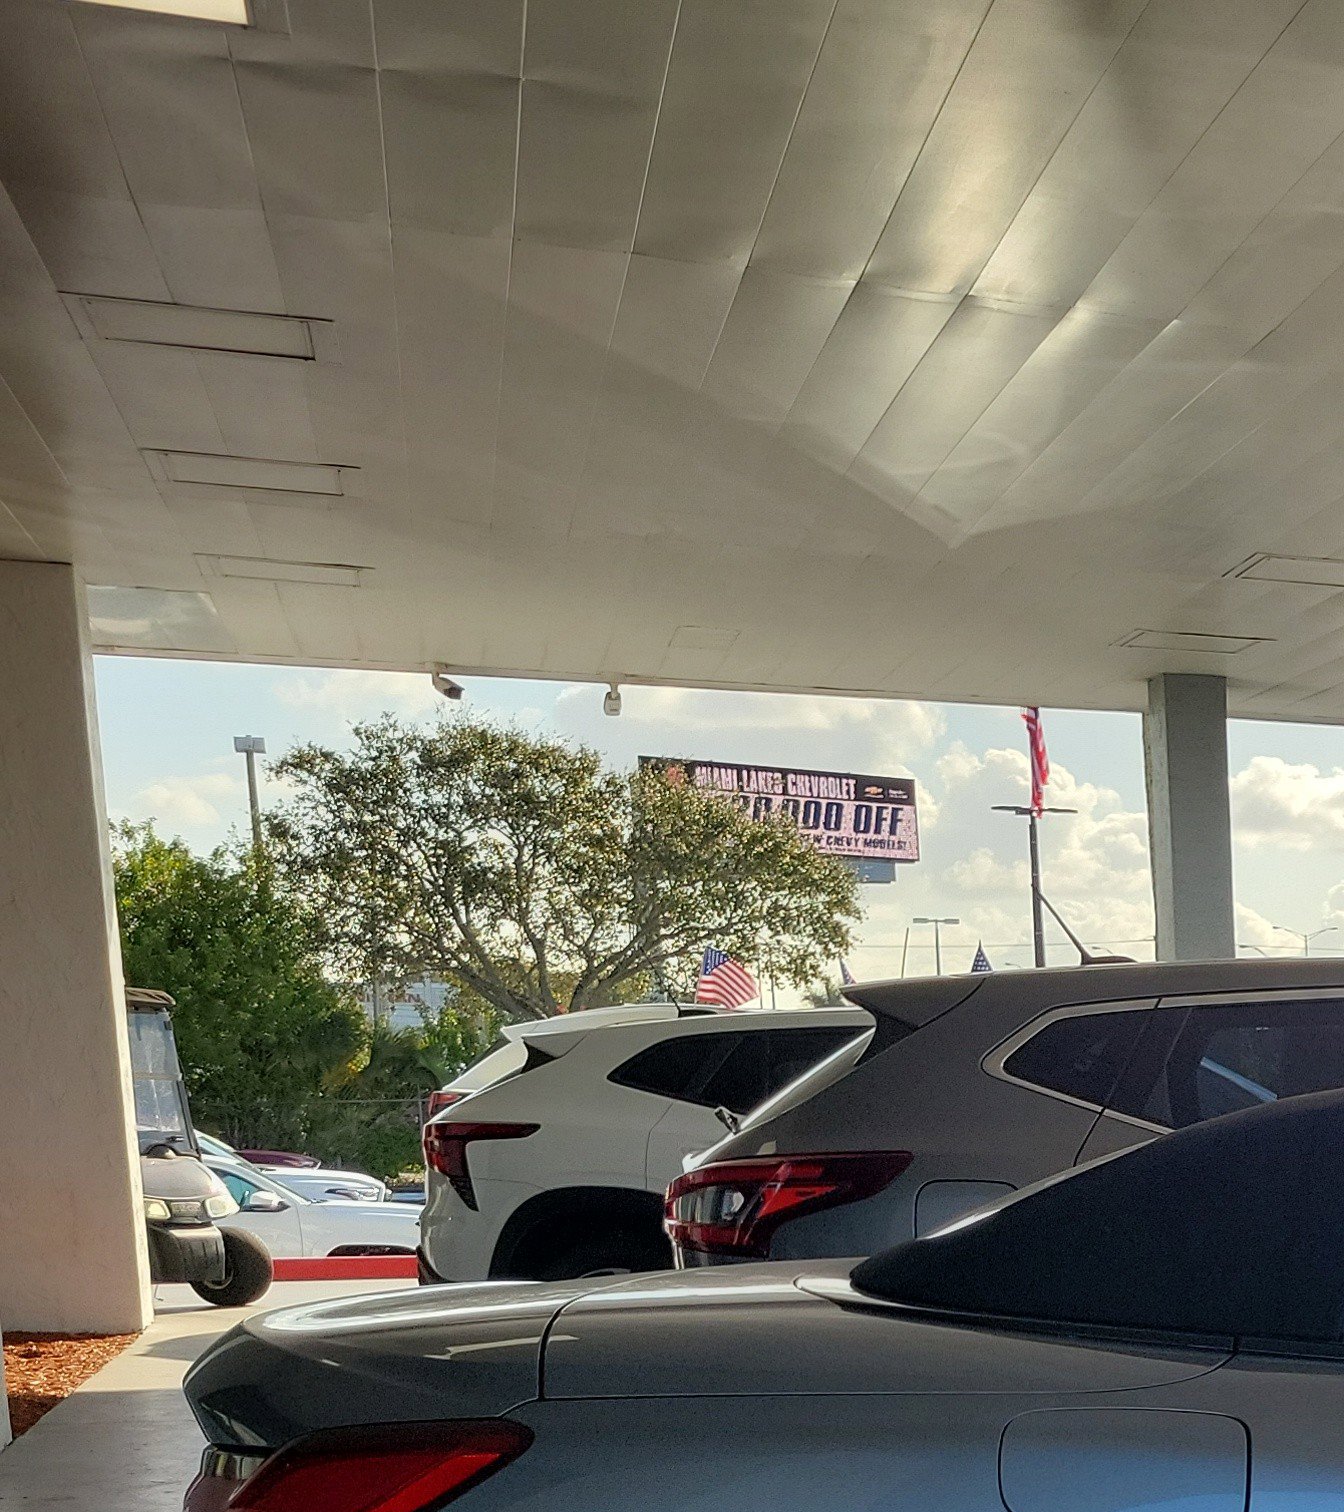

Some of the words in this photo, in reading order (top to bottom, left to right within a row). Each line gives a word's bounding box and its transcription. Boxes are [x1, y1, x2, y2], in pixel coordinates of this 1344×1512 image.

[742, 769, 783, 795] LAKES
[787, 773, 857, 800] CHEVROLET
[853, 803, 904, 836] OFF
